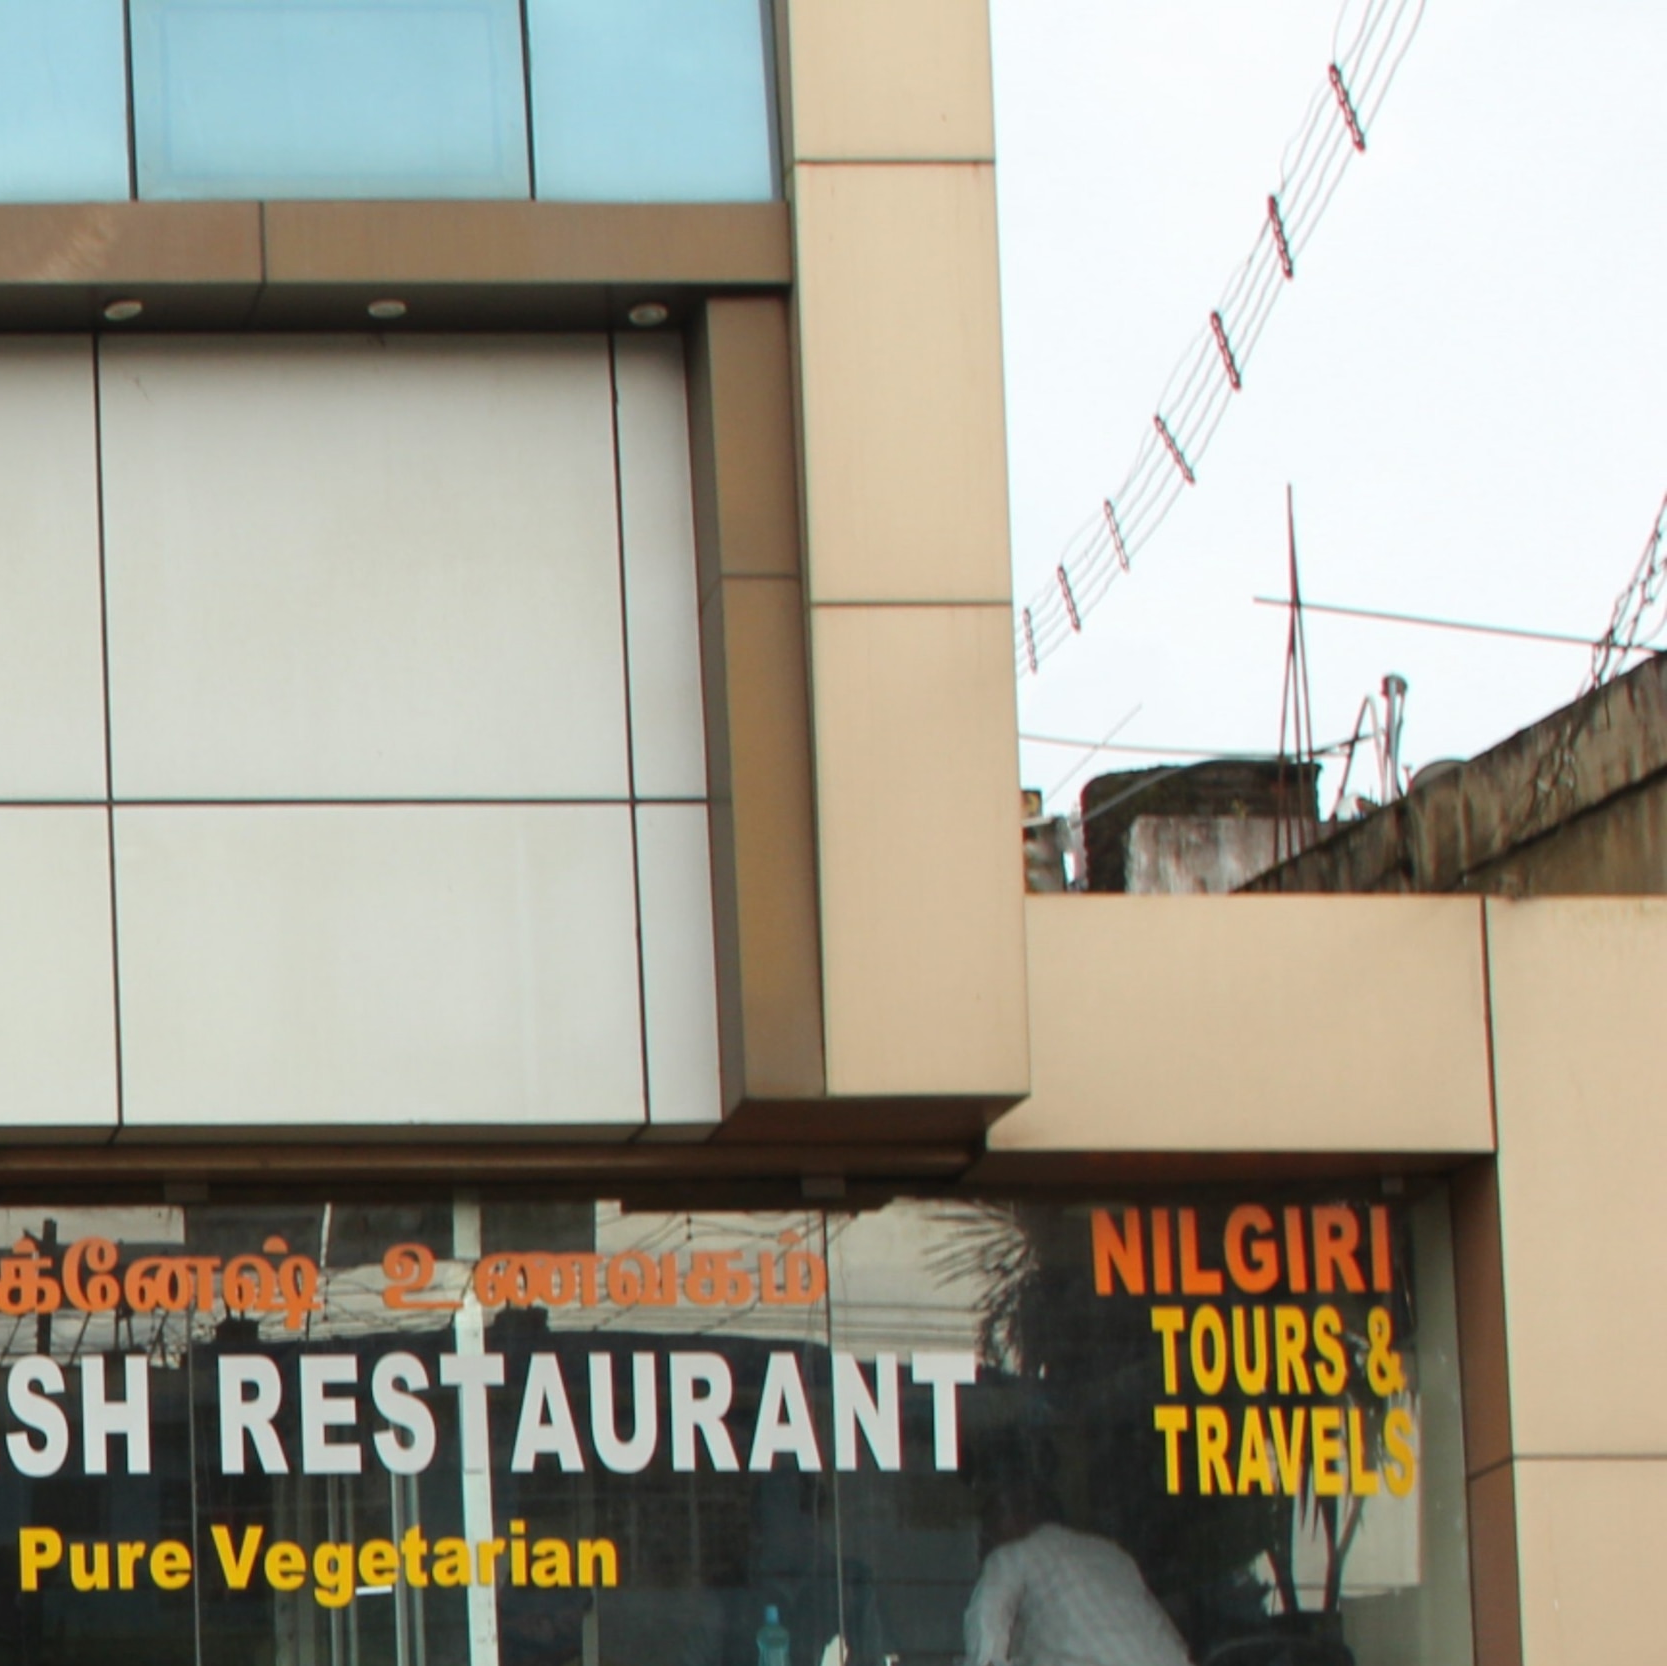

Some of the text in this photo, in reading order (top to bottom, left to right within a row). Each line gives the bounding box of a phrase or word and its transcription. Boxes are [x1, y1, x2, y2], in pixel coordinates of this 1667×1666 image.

[381, 1231, 829, 1311] உணவகம்
[1090, 1203, 1393, 1297] NILGIRI
[1150, 1305, 1406, 1398] TOURS &
[217, 1351, 978, 1476] RESTAURANT
[1153, 1405, 1419, 1497] TRAVELS
[18, 1518, 620, 1609] Pure Vegetarian
